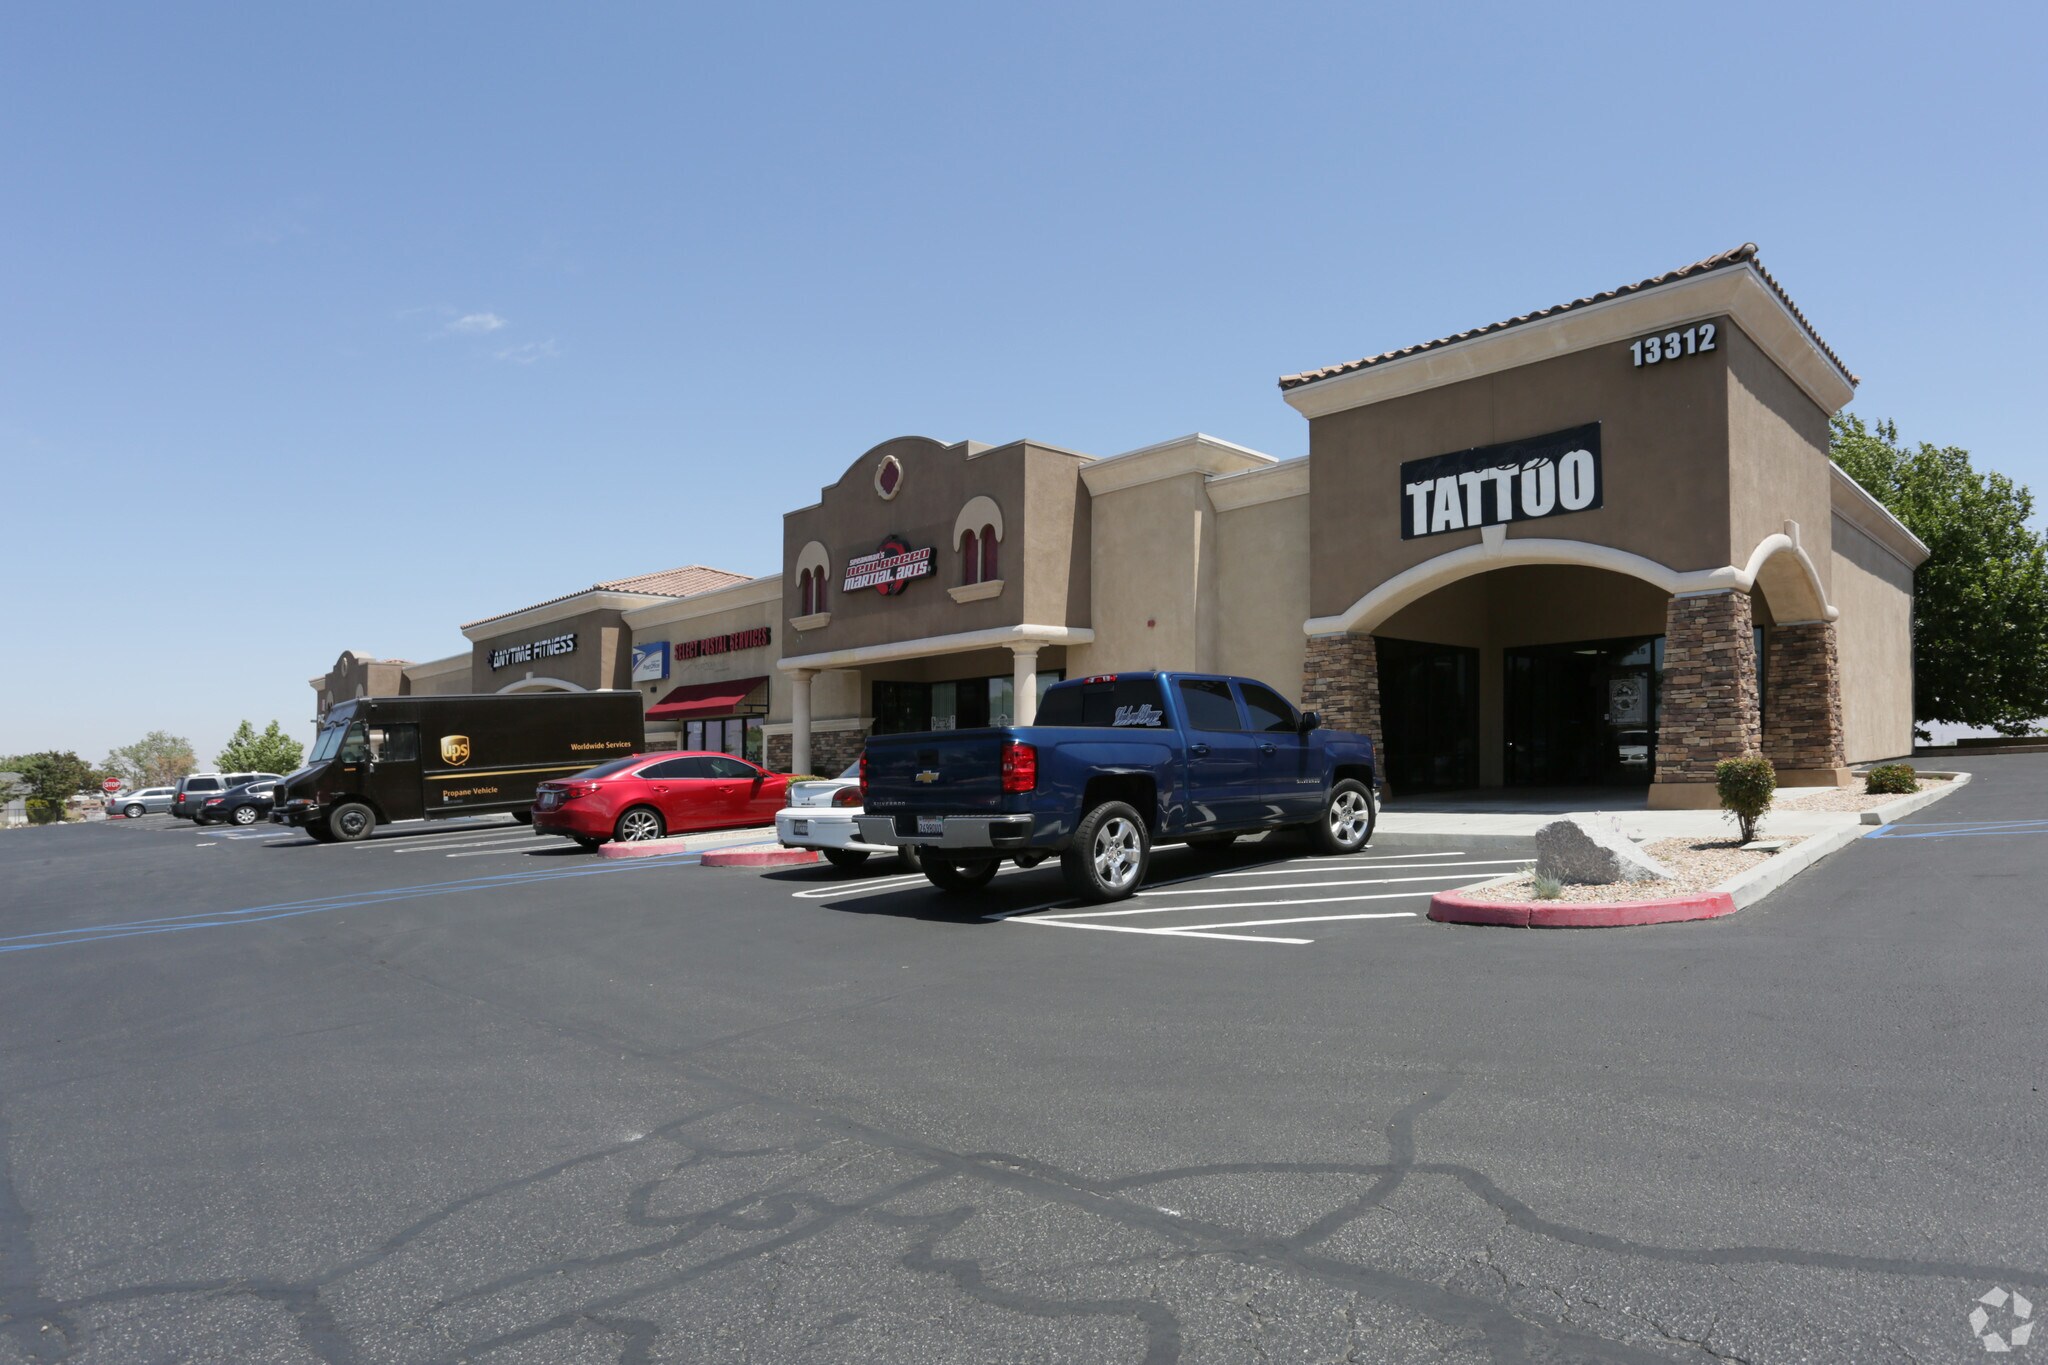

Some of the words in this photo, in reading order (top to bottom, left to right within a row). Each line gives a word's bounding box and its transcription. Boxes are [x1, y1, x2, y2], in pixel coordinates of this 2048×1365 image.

[1630, 323, 1716, 367] 13312
[1406, 449, 1595, 536] TATTOO
[493, 643, 531, 668] ANYTIME
[533, 633, 574, 660] FITNESS
[674, 640, 698, 661] SELECT
[700, 635, 727, 656] POSTAL
[729, 627, 768, 652] SERVICES
[570, 742, 605, 751] Worldwide
[605, 740, 631, 749] Services
[442, 789, 471, 798] Propane
[473, 787, 498, 795] Vehicle
